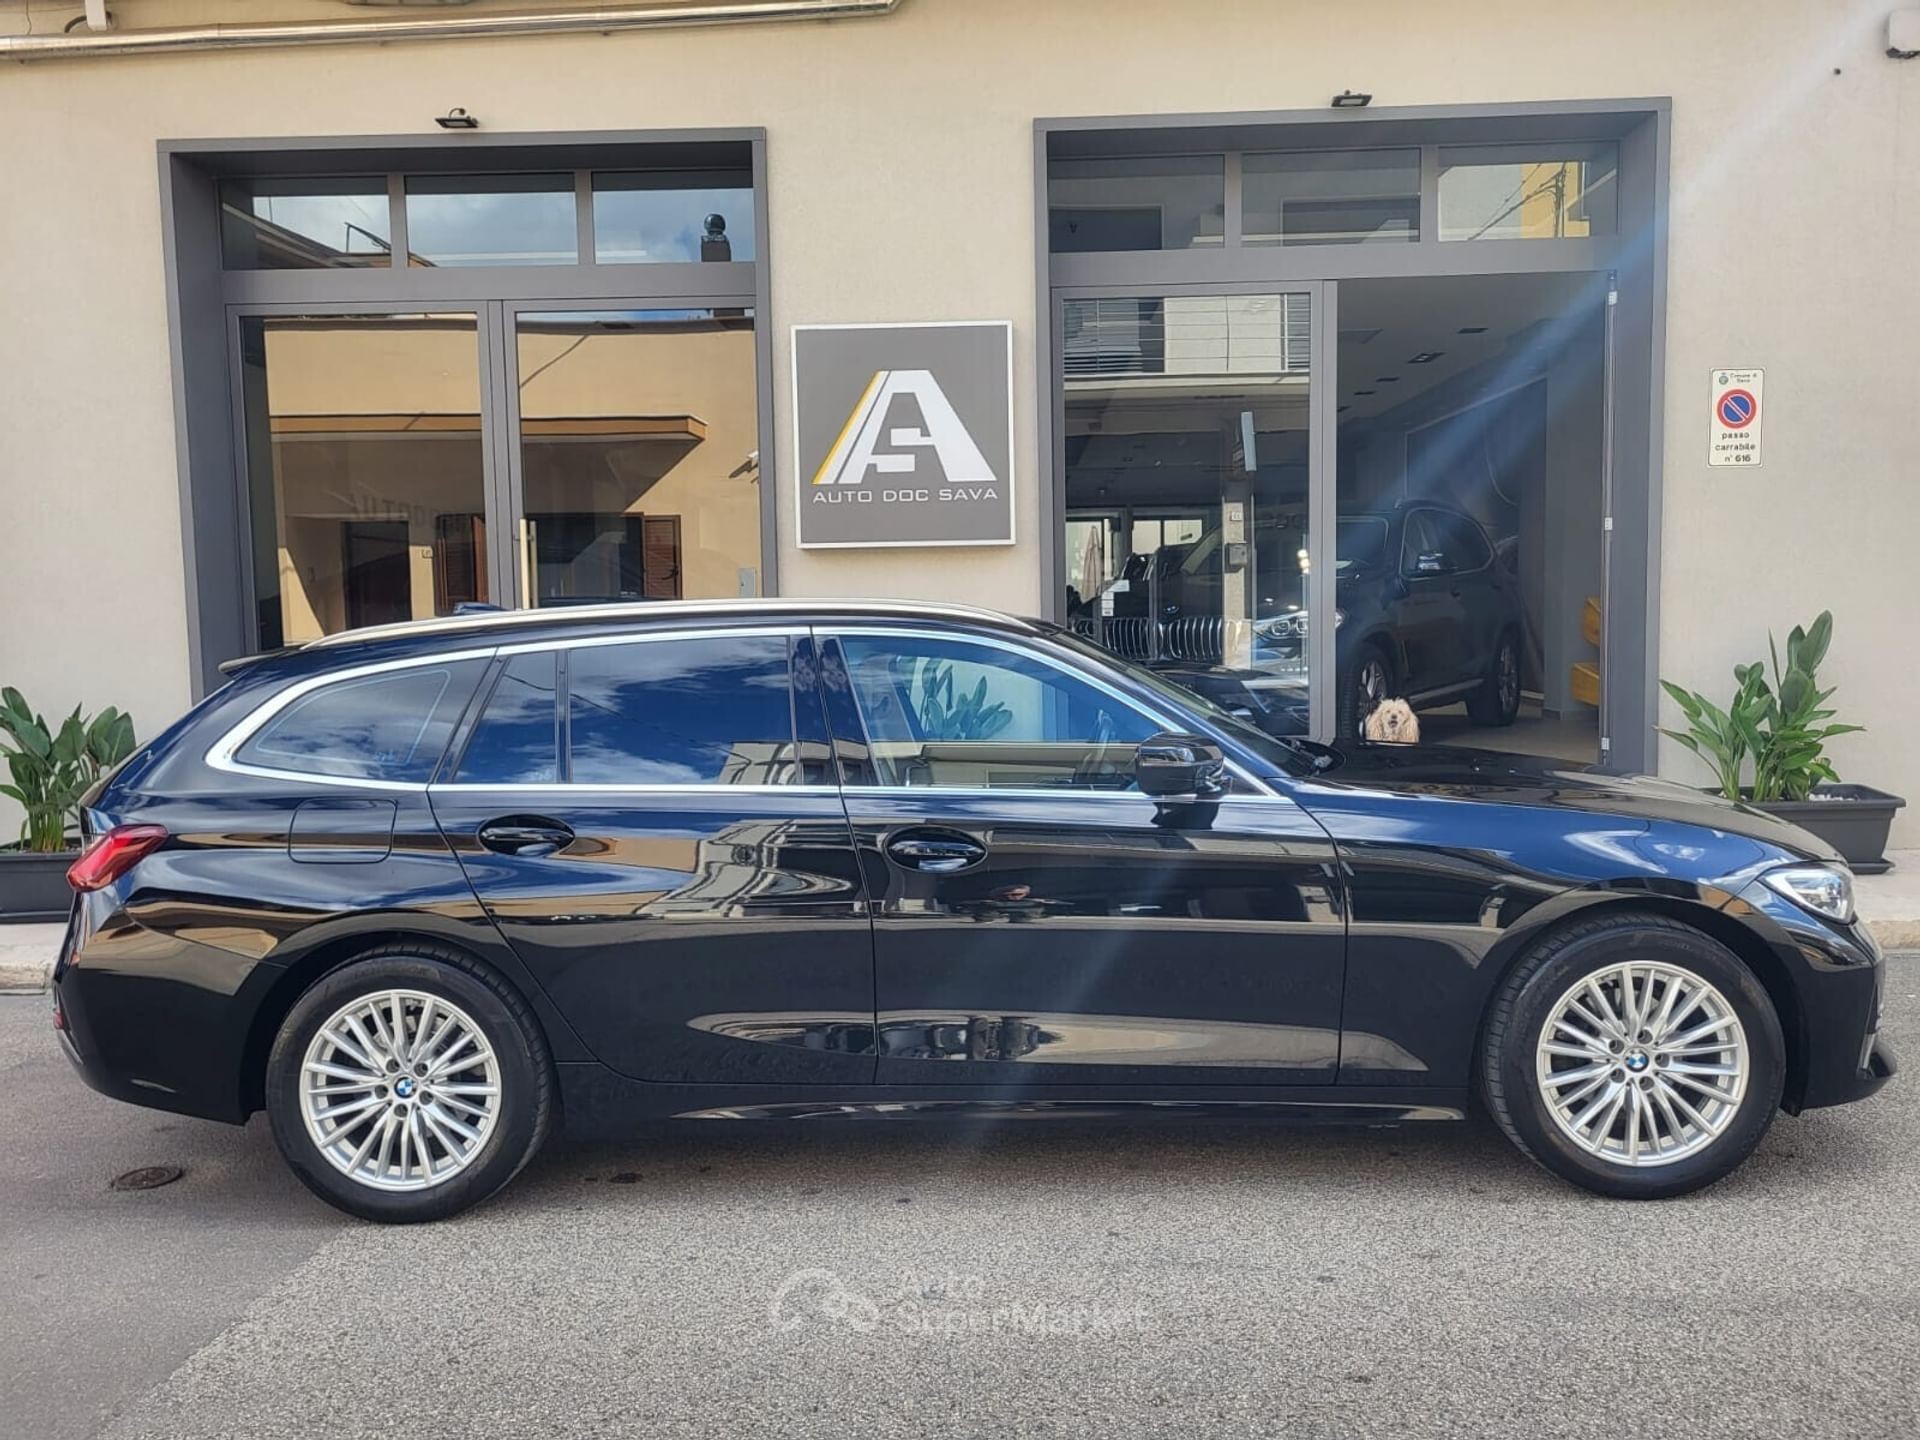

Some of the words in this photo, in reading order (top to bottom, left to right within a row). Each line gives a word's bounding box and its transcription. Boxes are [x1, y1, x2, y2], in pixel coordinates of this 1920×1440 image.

[1722, 432, 1750, 440] passo
[1715, 443, 1755, 451] carrabile
[1735, 454, 1751, 462] 616
[813, 490, 872, 504] AUTO
[883, 489, 929, 501] DOC
[939, 488, 998, 500] SAVA
